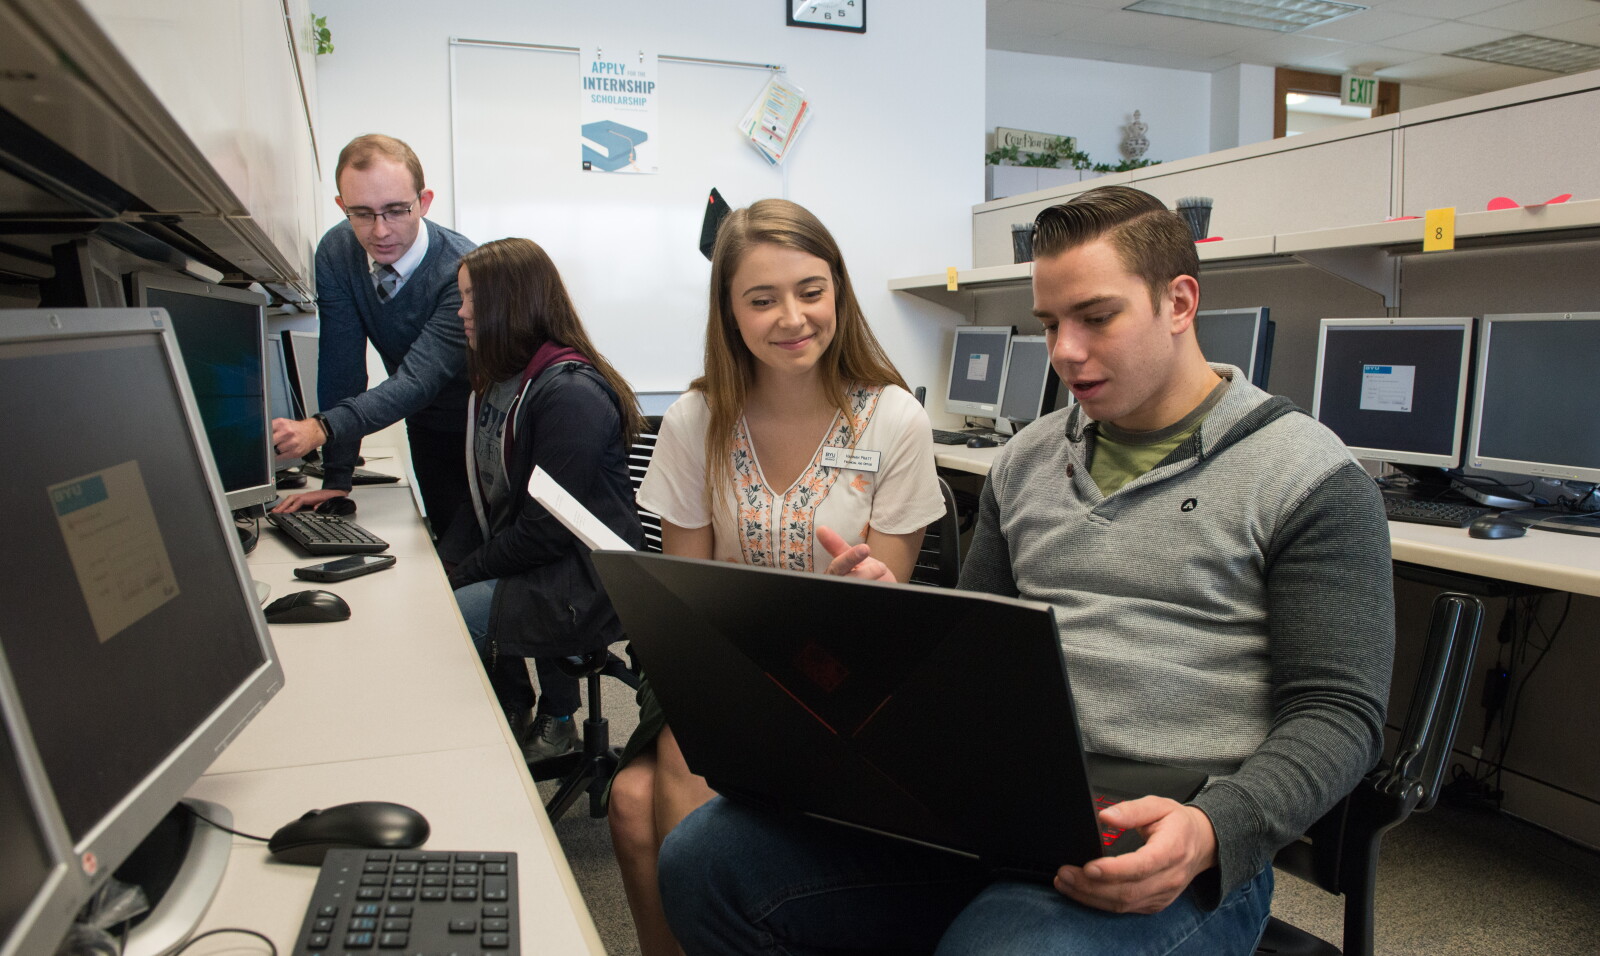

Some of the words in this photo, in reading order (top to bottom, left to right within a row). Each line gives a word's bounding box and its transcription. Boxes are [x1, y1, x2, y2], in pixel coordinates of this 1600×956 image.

[810, 6, 817, 14] 7
[824, 12, 832, 20] 6
[838, 9, 846, 17] 5
[591, 61, 626, 76] APPLY
[583, 76, 655, 95] INTERNSHIP
[1349, 77, 1376, 105] EXIT
[591, 94, 647, 107] SCHOLARSHIP
[1435, 226, 1443, 240] 8
[54, 484, 83, 502] BYU
